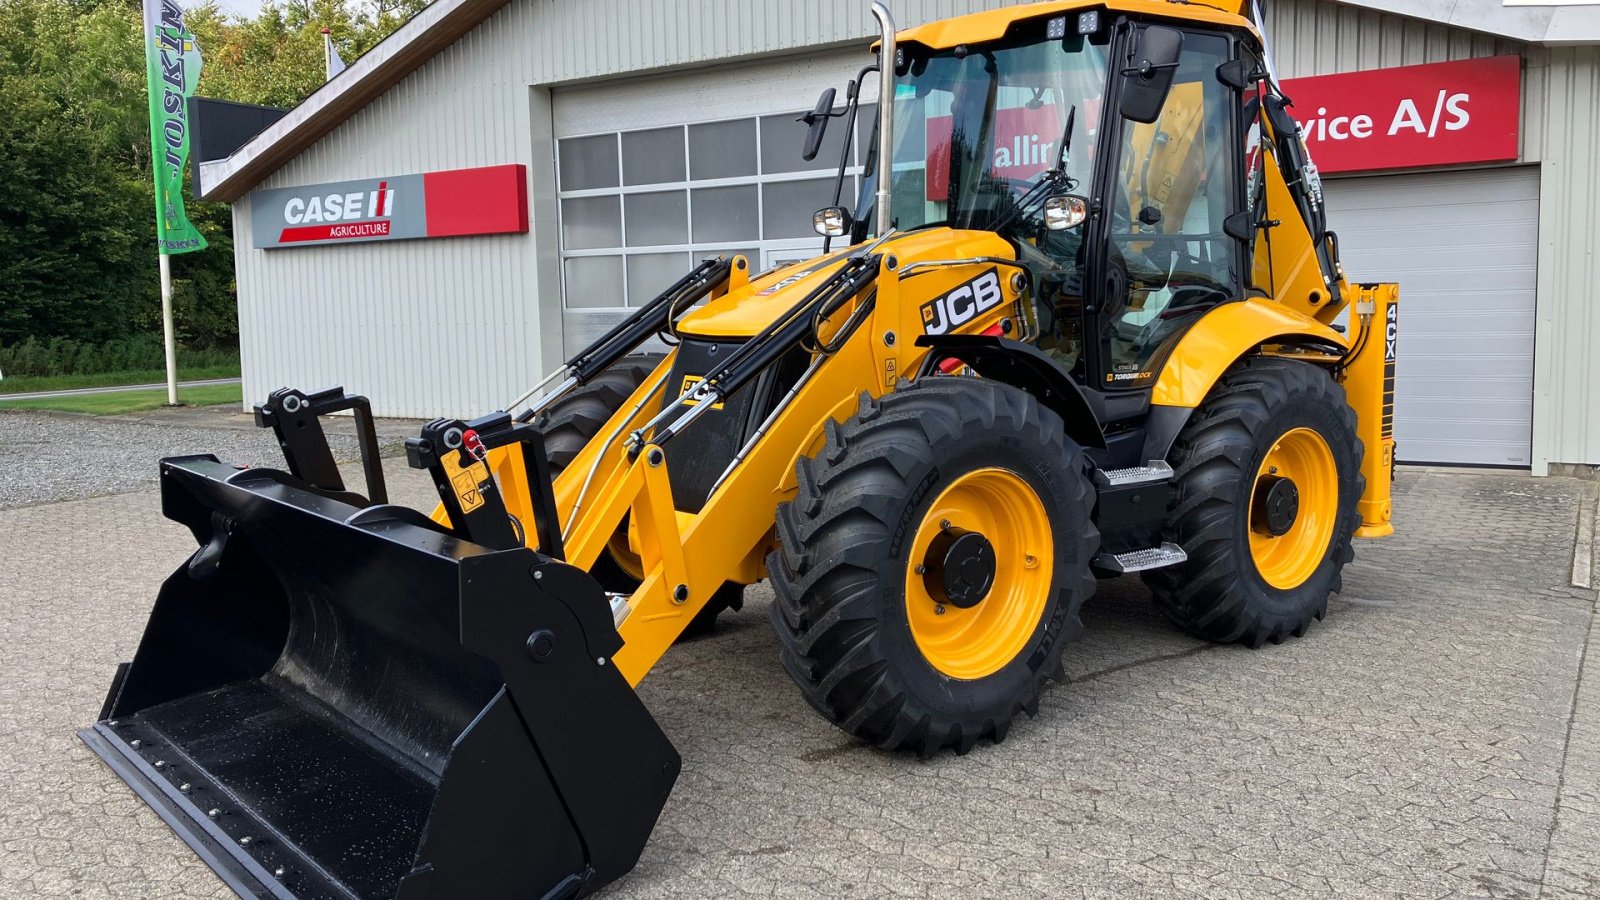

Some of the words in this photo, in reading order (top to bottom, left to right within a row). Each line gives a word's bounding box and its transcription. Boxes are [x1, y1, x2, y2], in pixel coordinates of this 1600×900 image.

[160, 0, 186, 180] JOSKIN
[1294, 106, 1373, 143] vice
[1386, 89, 1471, 138] A/S
[283, 191, 364, 225] CASE
[329, 223, 388, 237] AGRICULTURE
[925, 271, 1002, 336] JCB
[1385, 303, 1397, 358] 4CX
[683, 381, 712, 401] JC
[1114, 371, 1153, 381] TORQUELOCK
